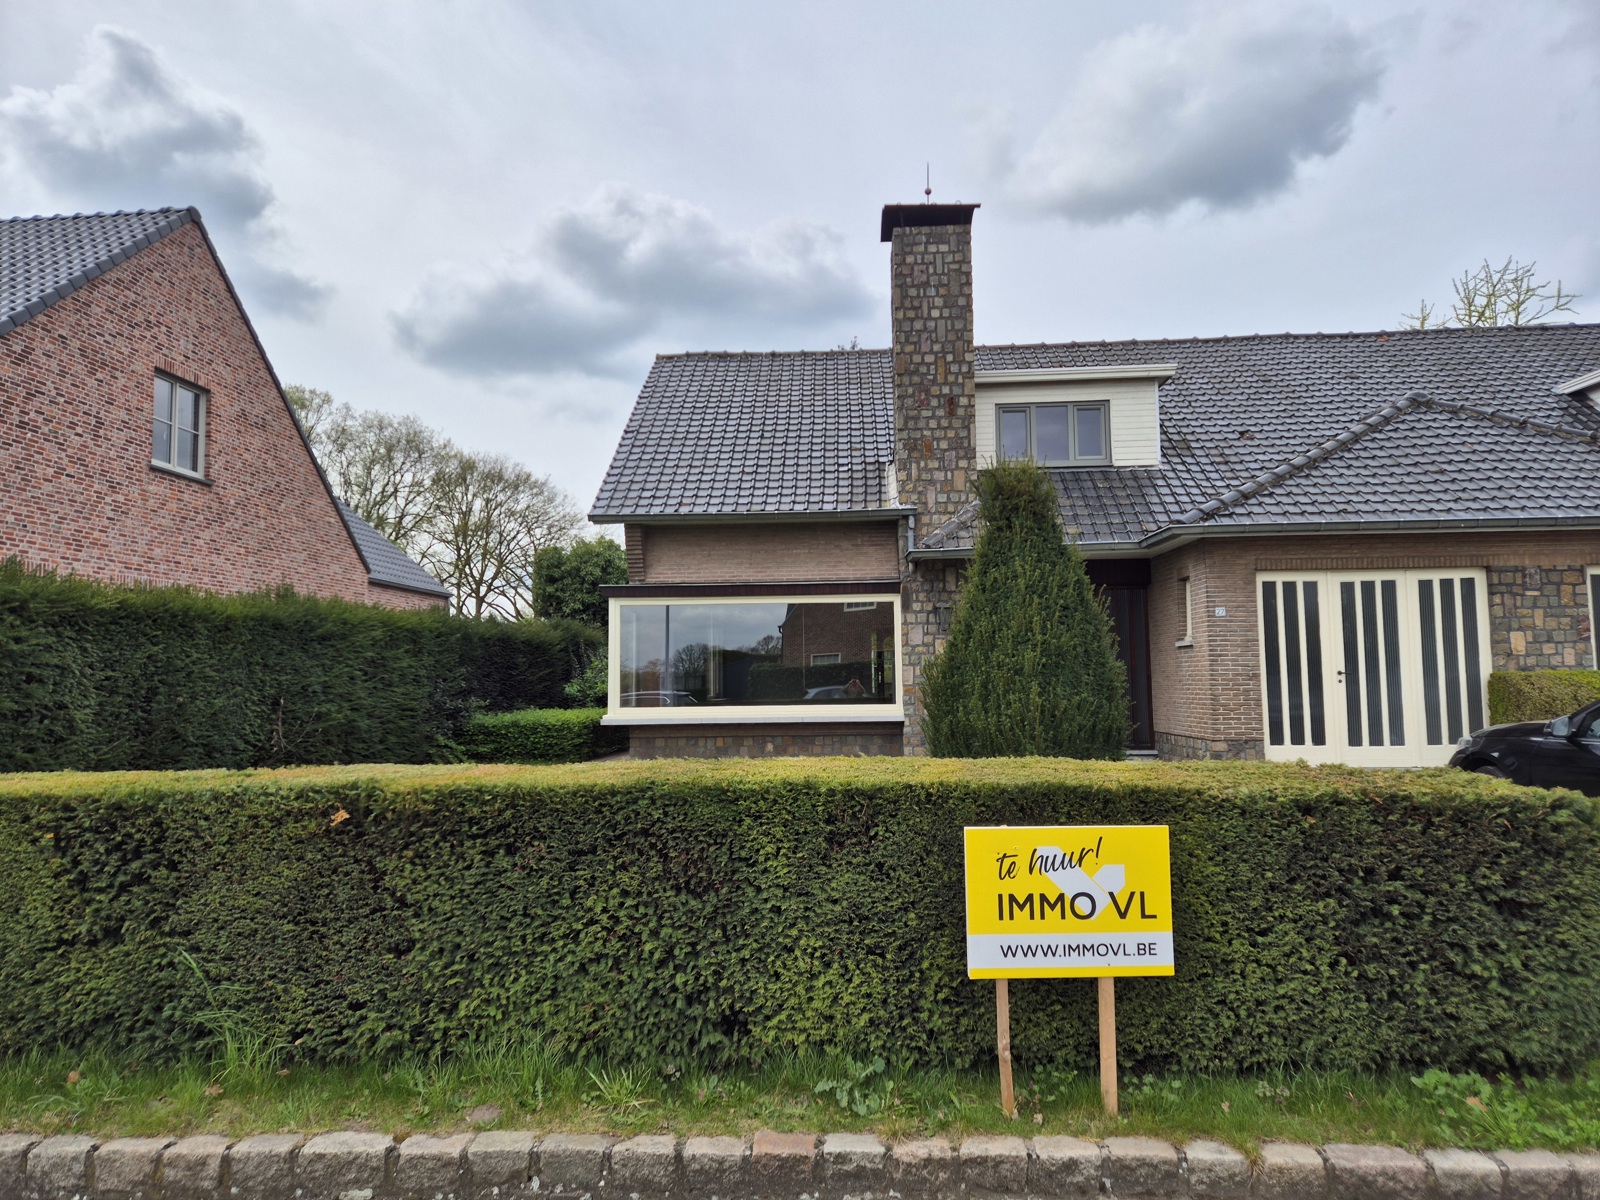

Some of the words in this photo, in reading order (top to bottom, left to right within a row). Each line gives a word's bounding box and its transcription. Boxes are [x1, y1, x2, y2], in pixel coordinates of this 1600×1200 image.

[996, 852, 1019, 881] te
[1028, 836, 1103, 876] huur!
[1000, 942, 1158, 958] WWW.IMMOVL.BE
